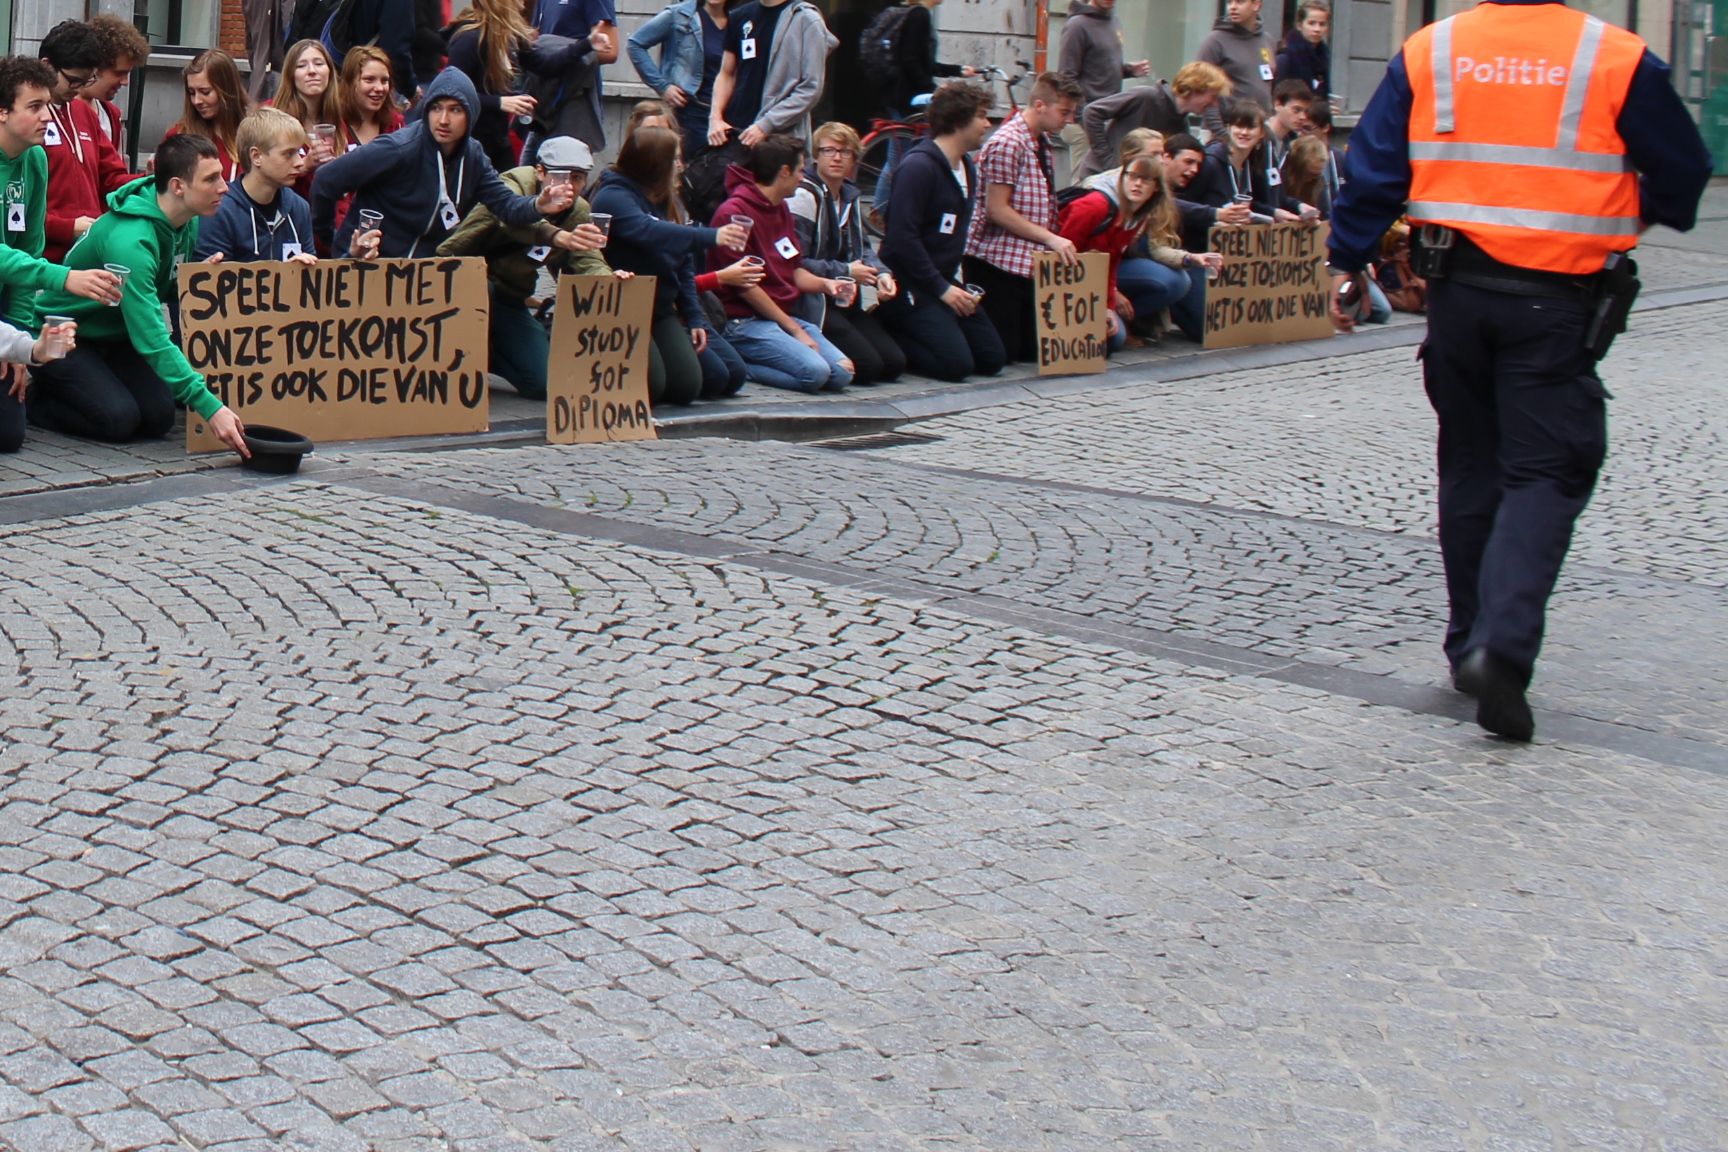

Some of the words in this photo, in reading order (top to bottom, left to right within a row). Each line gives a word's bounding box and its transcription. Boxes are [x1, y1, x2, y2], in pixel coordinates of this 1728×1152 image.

[1455, 56, 1567, 85] Politie
[1211, 228, 1253, 258] SPEEL
[1257, 226, 1290, 257] NIET
[1290, 225, 1320, 257] MET
[189, 267, 291, 320] SPEEL
[300, 261, 379, 310] NIET
[386, 259, 462, 307] MET
[1040, 259, 1085, 288] NEED
[1206, 297, 1231, 335] HET
[1231, 297, 1245, 326] IS
[1248, 297, 1274, 324] OOK
[1277, 295, 1298, 320] DIE
[1302, 292, 1325, 318] VAN
[188, 325, 273, 369] ONZE
[278, 307, 464, 372] TOEKOMST,
[237, 372, 264, 408] IS
[272, 367, 328, 403] OOK
[337, 367, 388, 404] DIE
[394, 365, 448, 405] VAN
[459, 370, 483, 409] U
